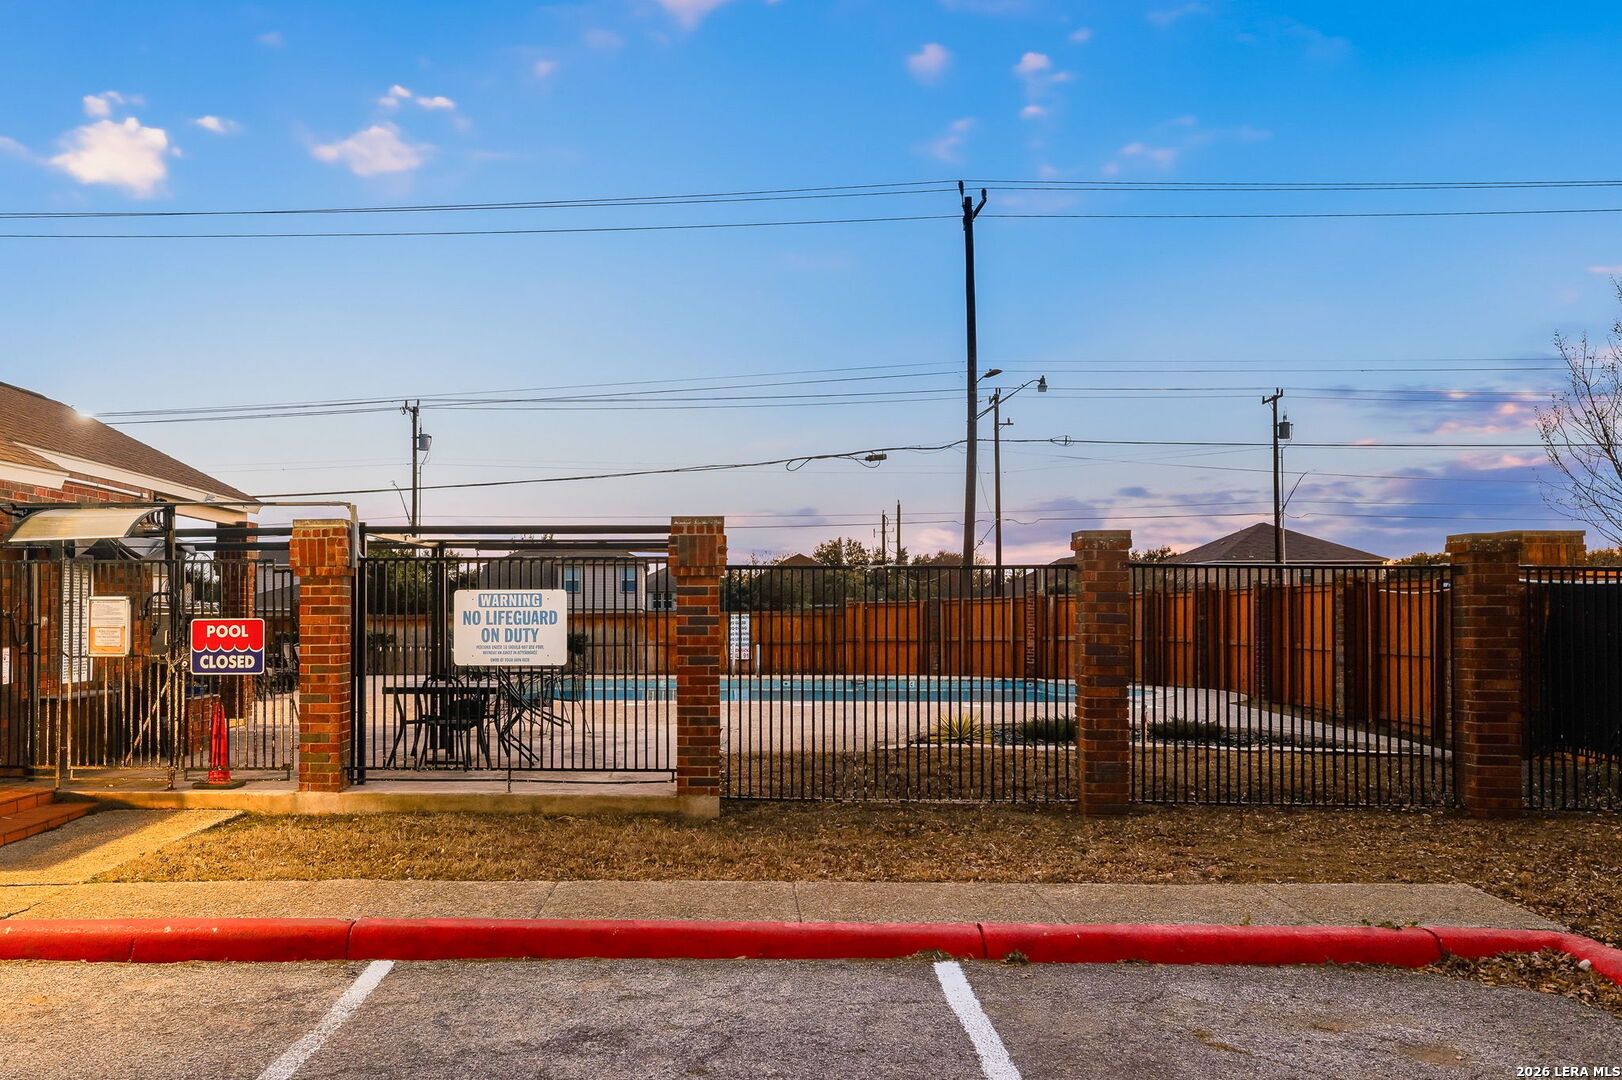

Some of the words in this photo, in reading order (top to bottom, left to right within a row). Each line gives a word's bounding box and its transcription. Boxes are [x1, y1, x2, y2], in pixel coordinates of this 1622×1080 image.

[480, 594, 540, 607] WARNING
[463, 610, 481, 625] NO
[485, 610, 558, 625] LIFEGUARD
[206, 624, 249, 638] POOL
[481, 628, 500, 643] ON
[504, 628, 539, 643] DUTY
[199, 655, 256, 669] CLOSED
